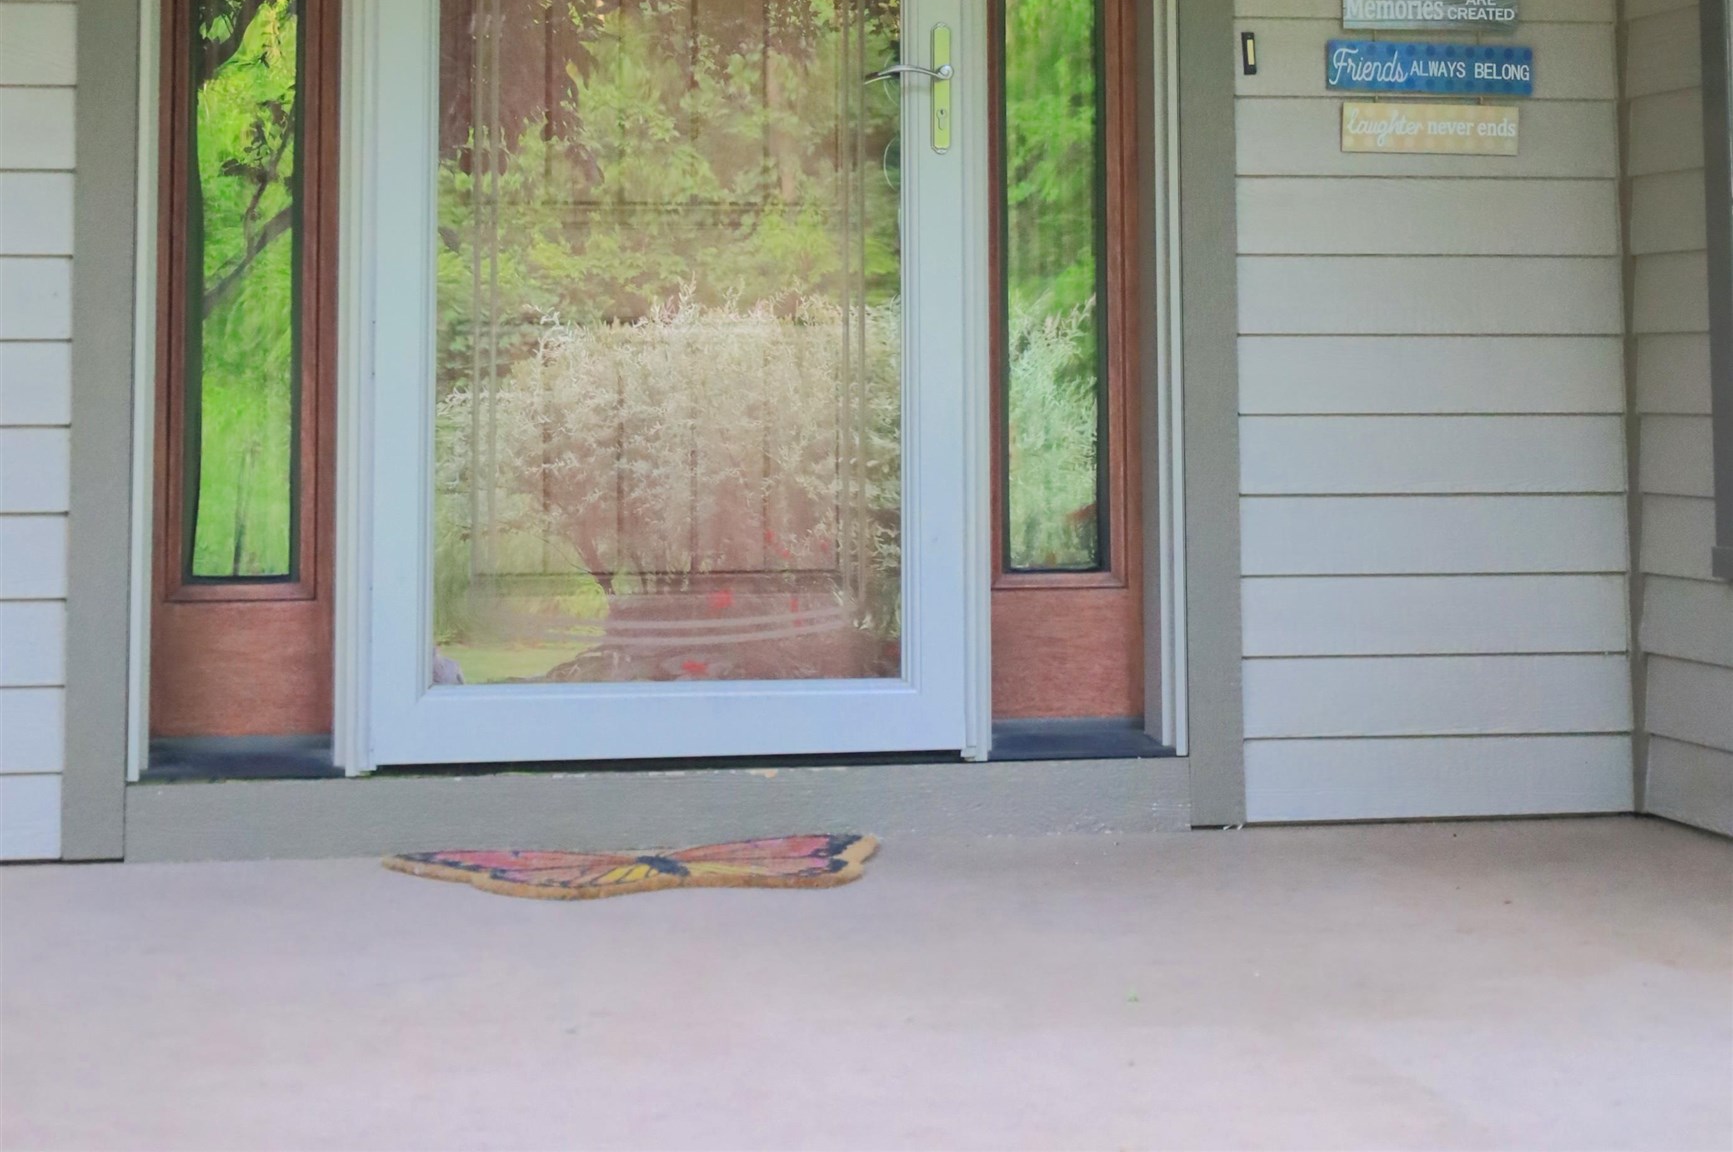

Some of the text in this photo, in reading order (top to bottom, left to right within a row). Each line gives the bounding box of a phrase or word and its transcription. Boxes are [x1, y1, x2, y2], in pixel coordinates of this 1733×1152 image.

[1447, 7, 1515, 21] CREATED
[1328, 48, 1530, 85] Friends ALWAYS BELONG
[1427, 119, 1474, 136] never
[1477, 118, 1516, 137] ends
